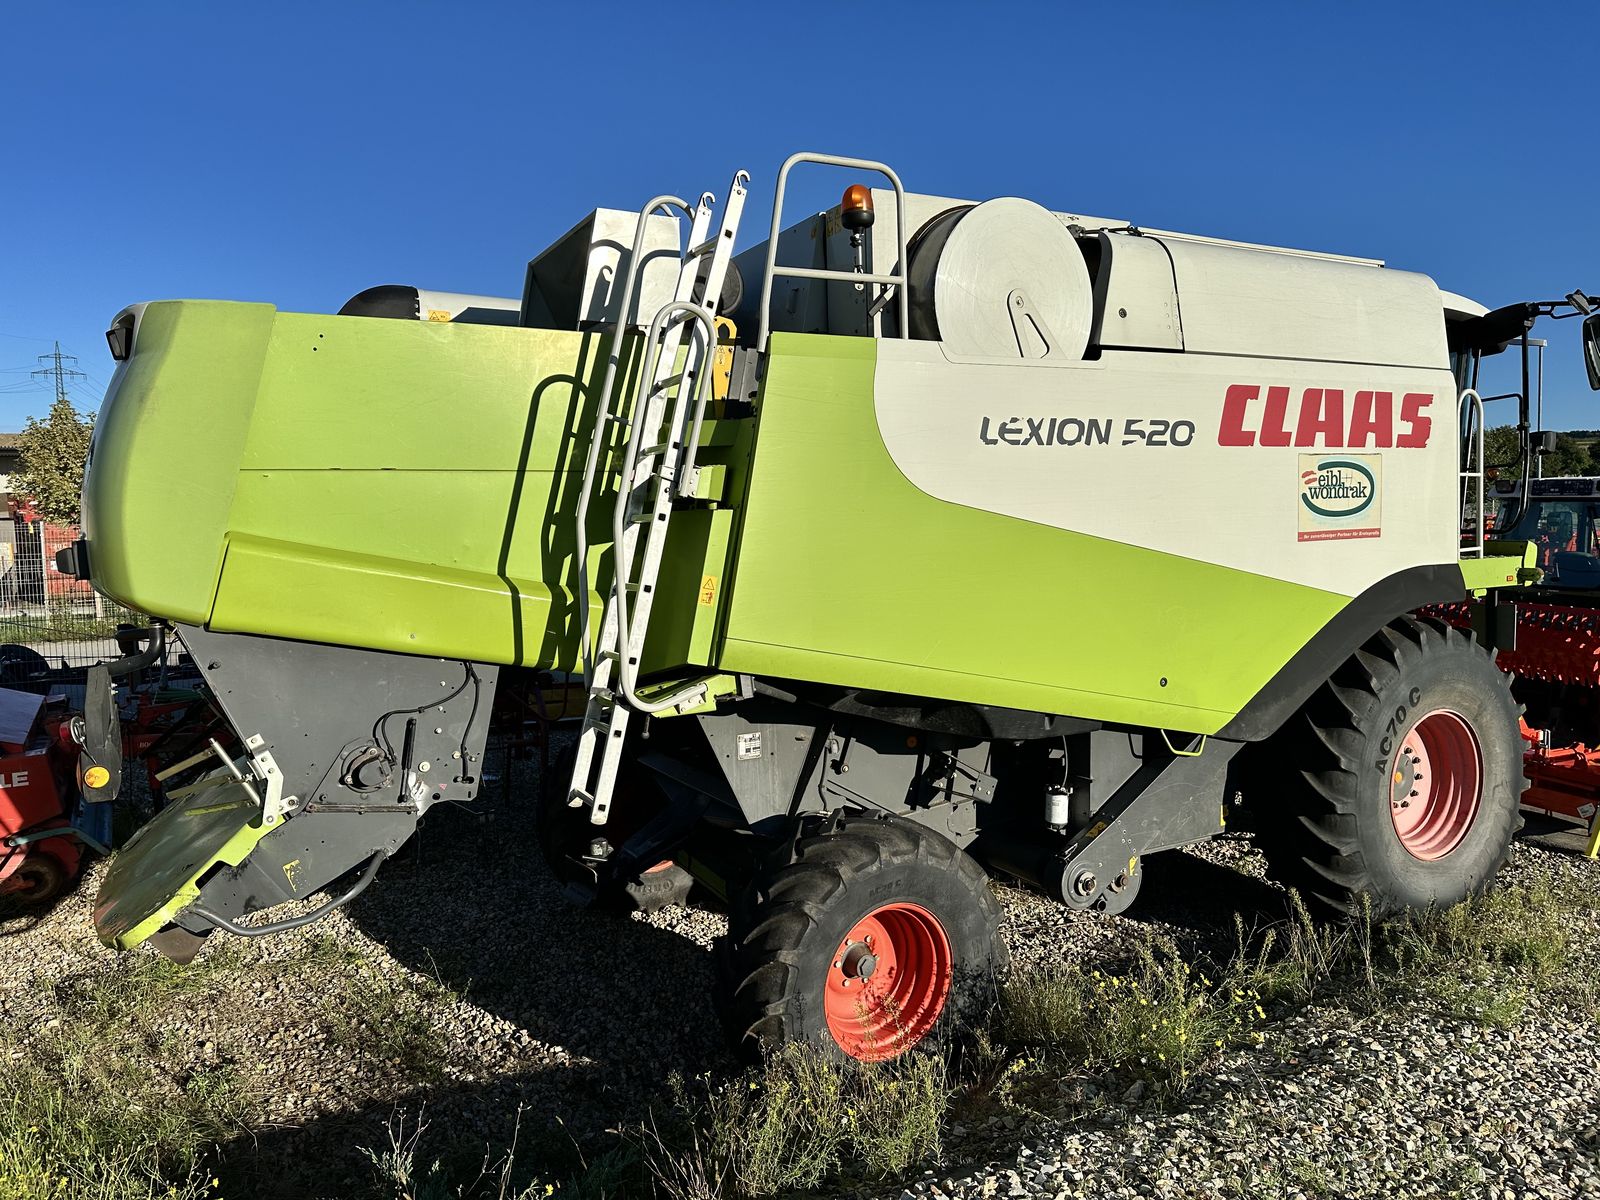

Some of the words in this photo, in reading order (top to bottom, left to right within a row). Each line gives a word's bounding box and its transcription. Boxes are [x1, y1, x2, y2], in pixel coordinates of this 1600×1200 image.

[980, 416, 1112, 446] LEXION
[1122, 418, 1195, 447] 520
[1218, 384, 1433, 449] CLAAS
[1308, 482, 1367, 499] wondrak
[1374, 705, 1407, 776] AC70
[1409, 686, 1421, 708] G
